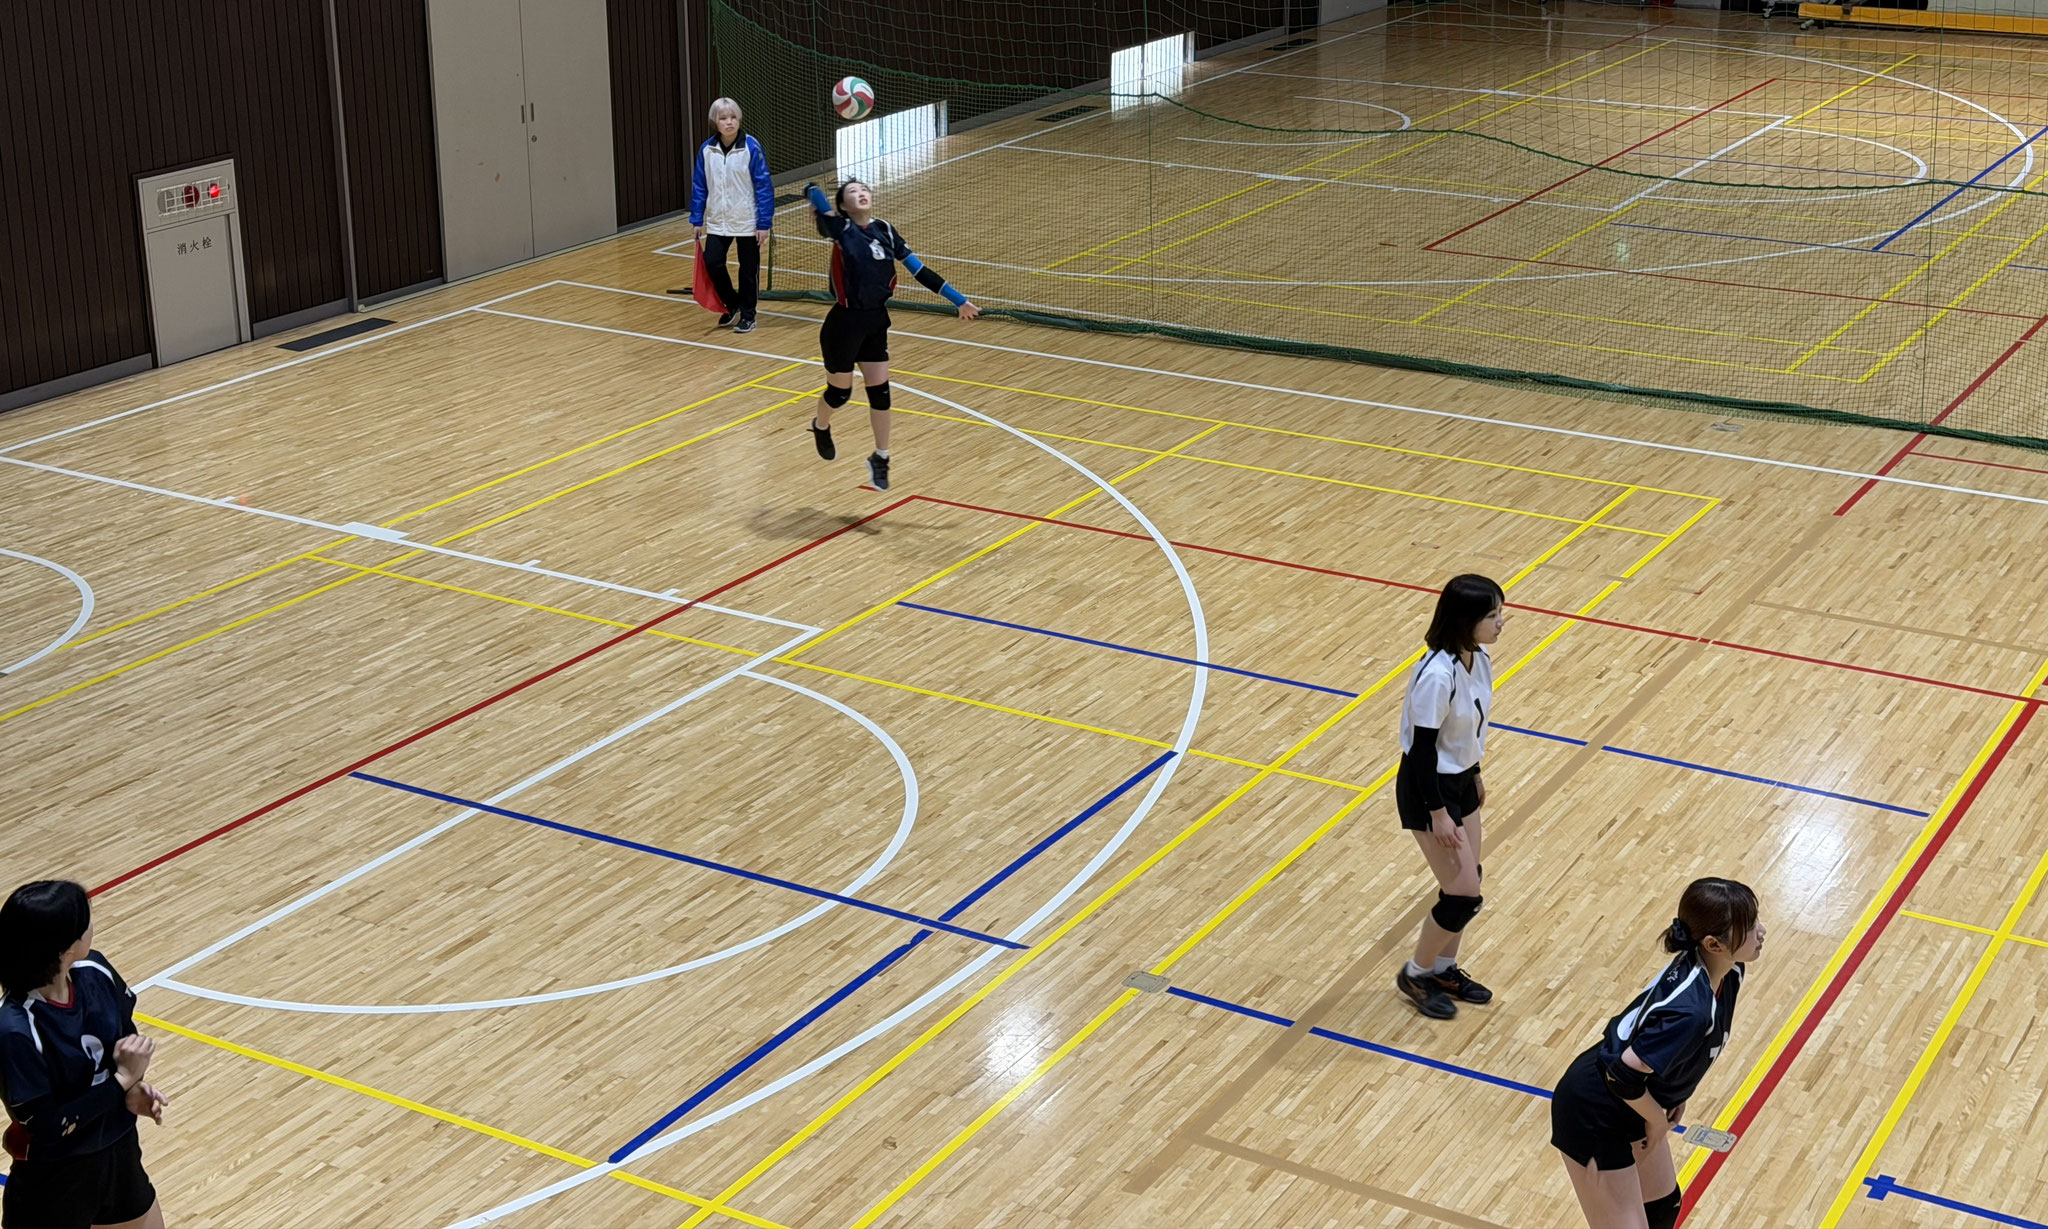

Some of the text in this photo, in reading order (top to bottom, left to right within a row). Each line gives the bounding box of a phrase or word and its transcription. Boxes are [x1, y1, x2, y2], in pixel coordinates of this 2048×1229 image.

[177, 236, 212, 256] 消火栓
[80, 1034, 110, 1087] 2
